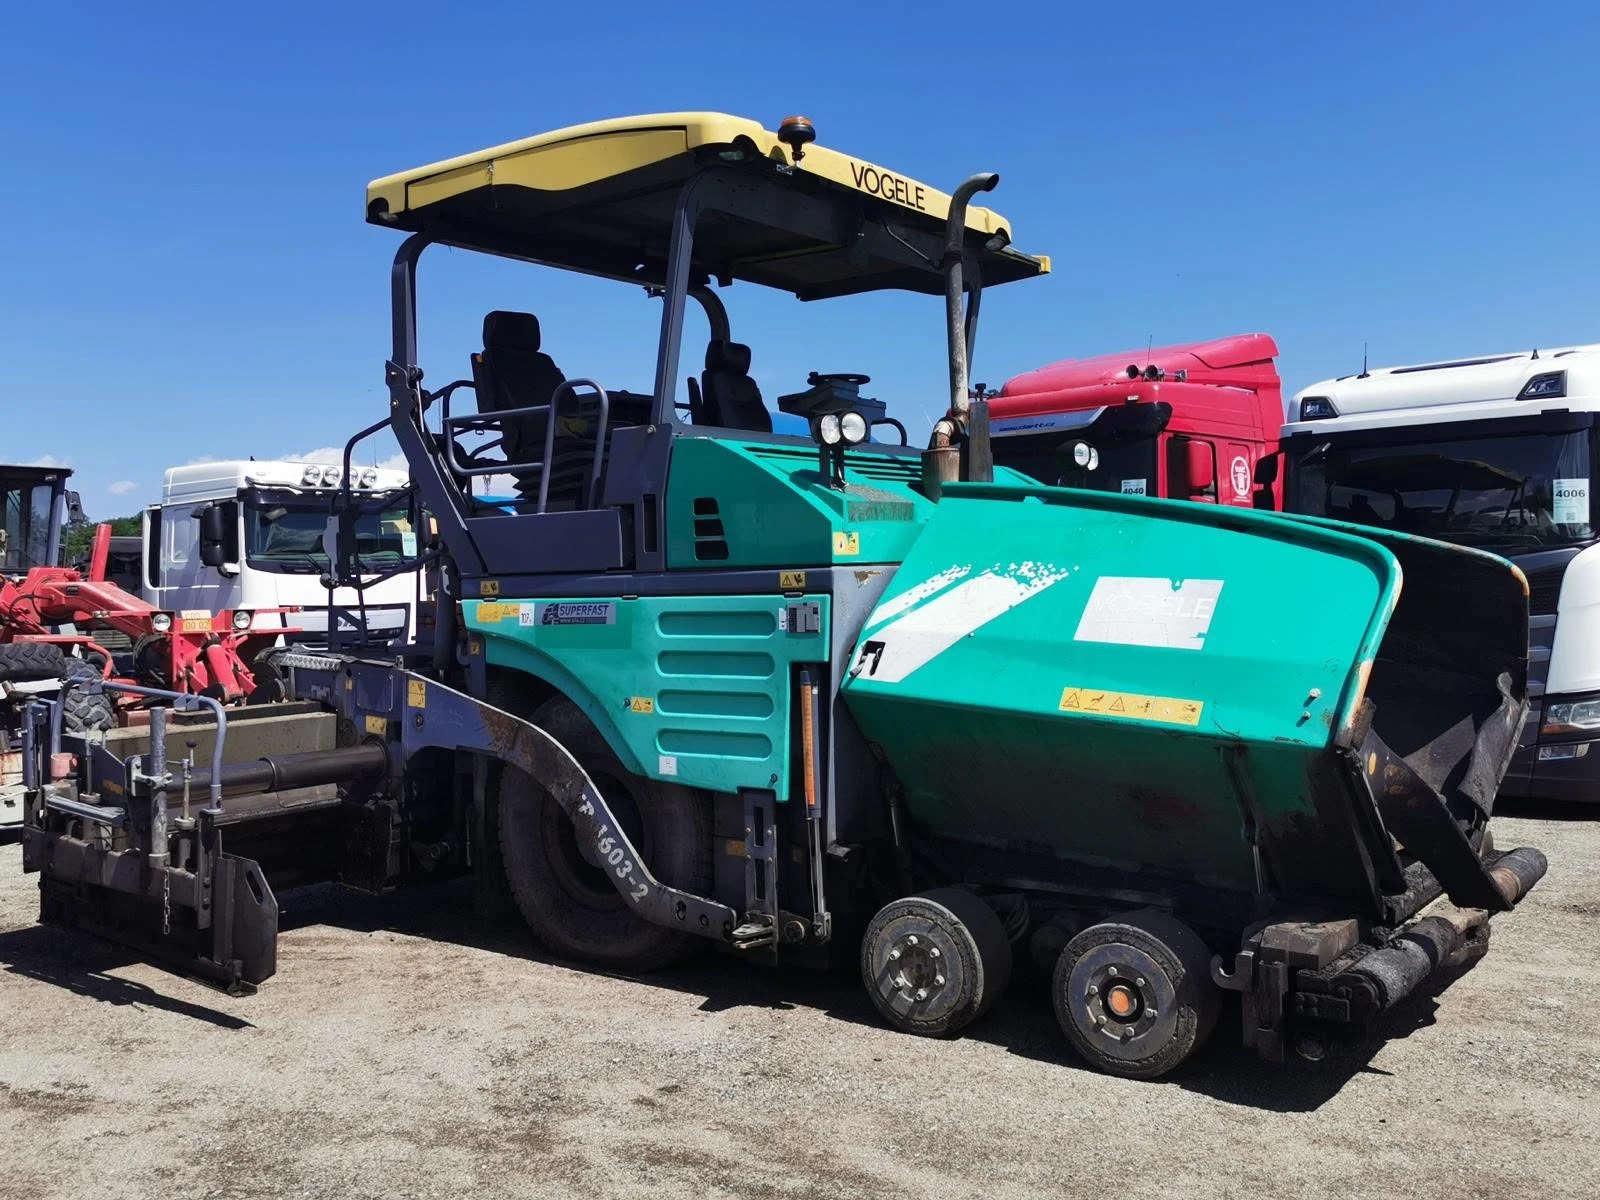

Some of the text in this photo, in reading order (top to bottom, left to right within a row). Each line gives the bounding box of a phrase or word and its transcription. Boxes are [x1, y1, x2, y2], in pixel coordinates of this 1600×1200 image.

[850, 162, 925, 211] VÖGELE
[1555, 489, 1586, 498] 4006
[559, 604, 609, 616] SUPERFAST
[597, 824, 649, 903] 1603-2
